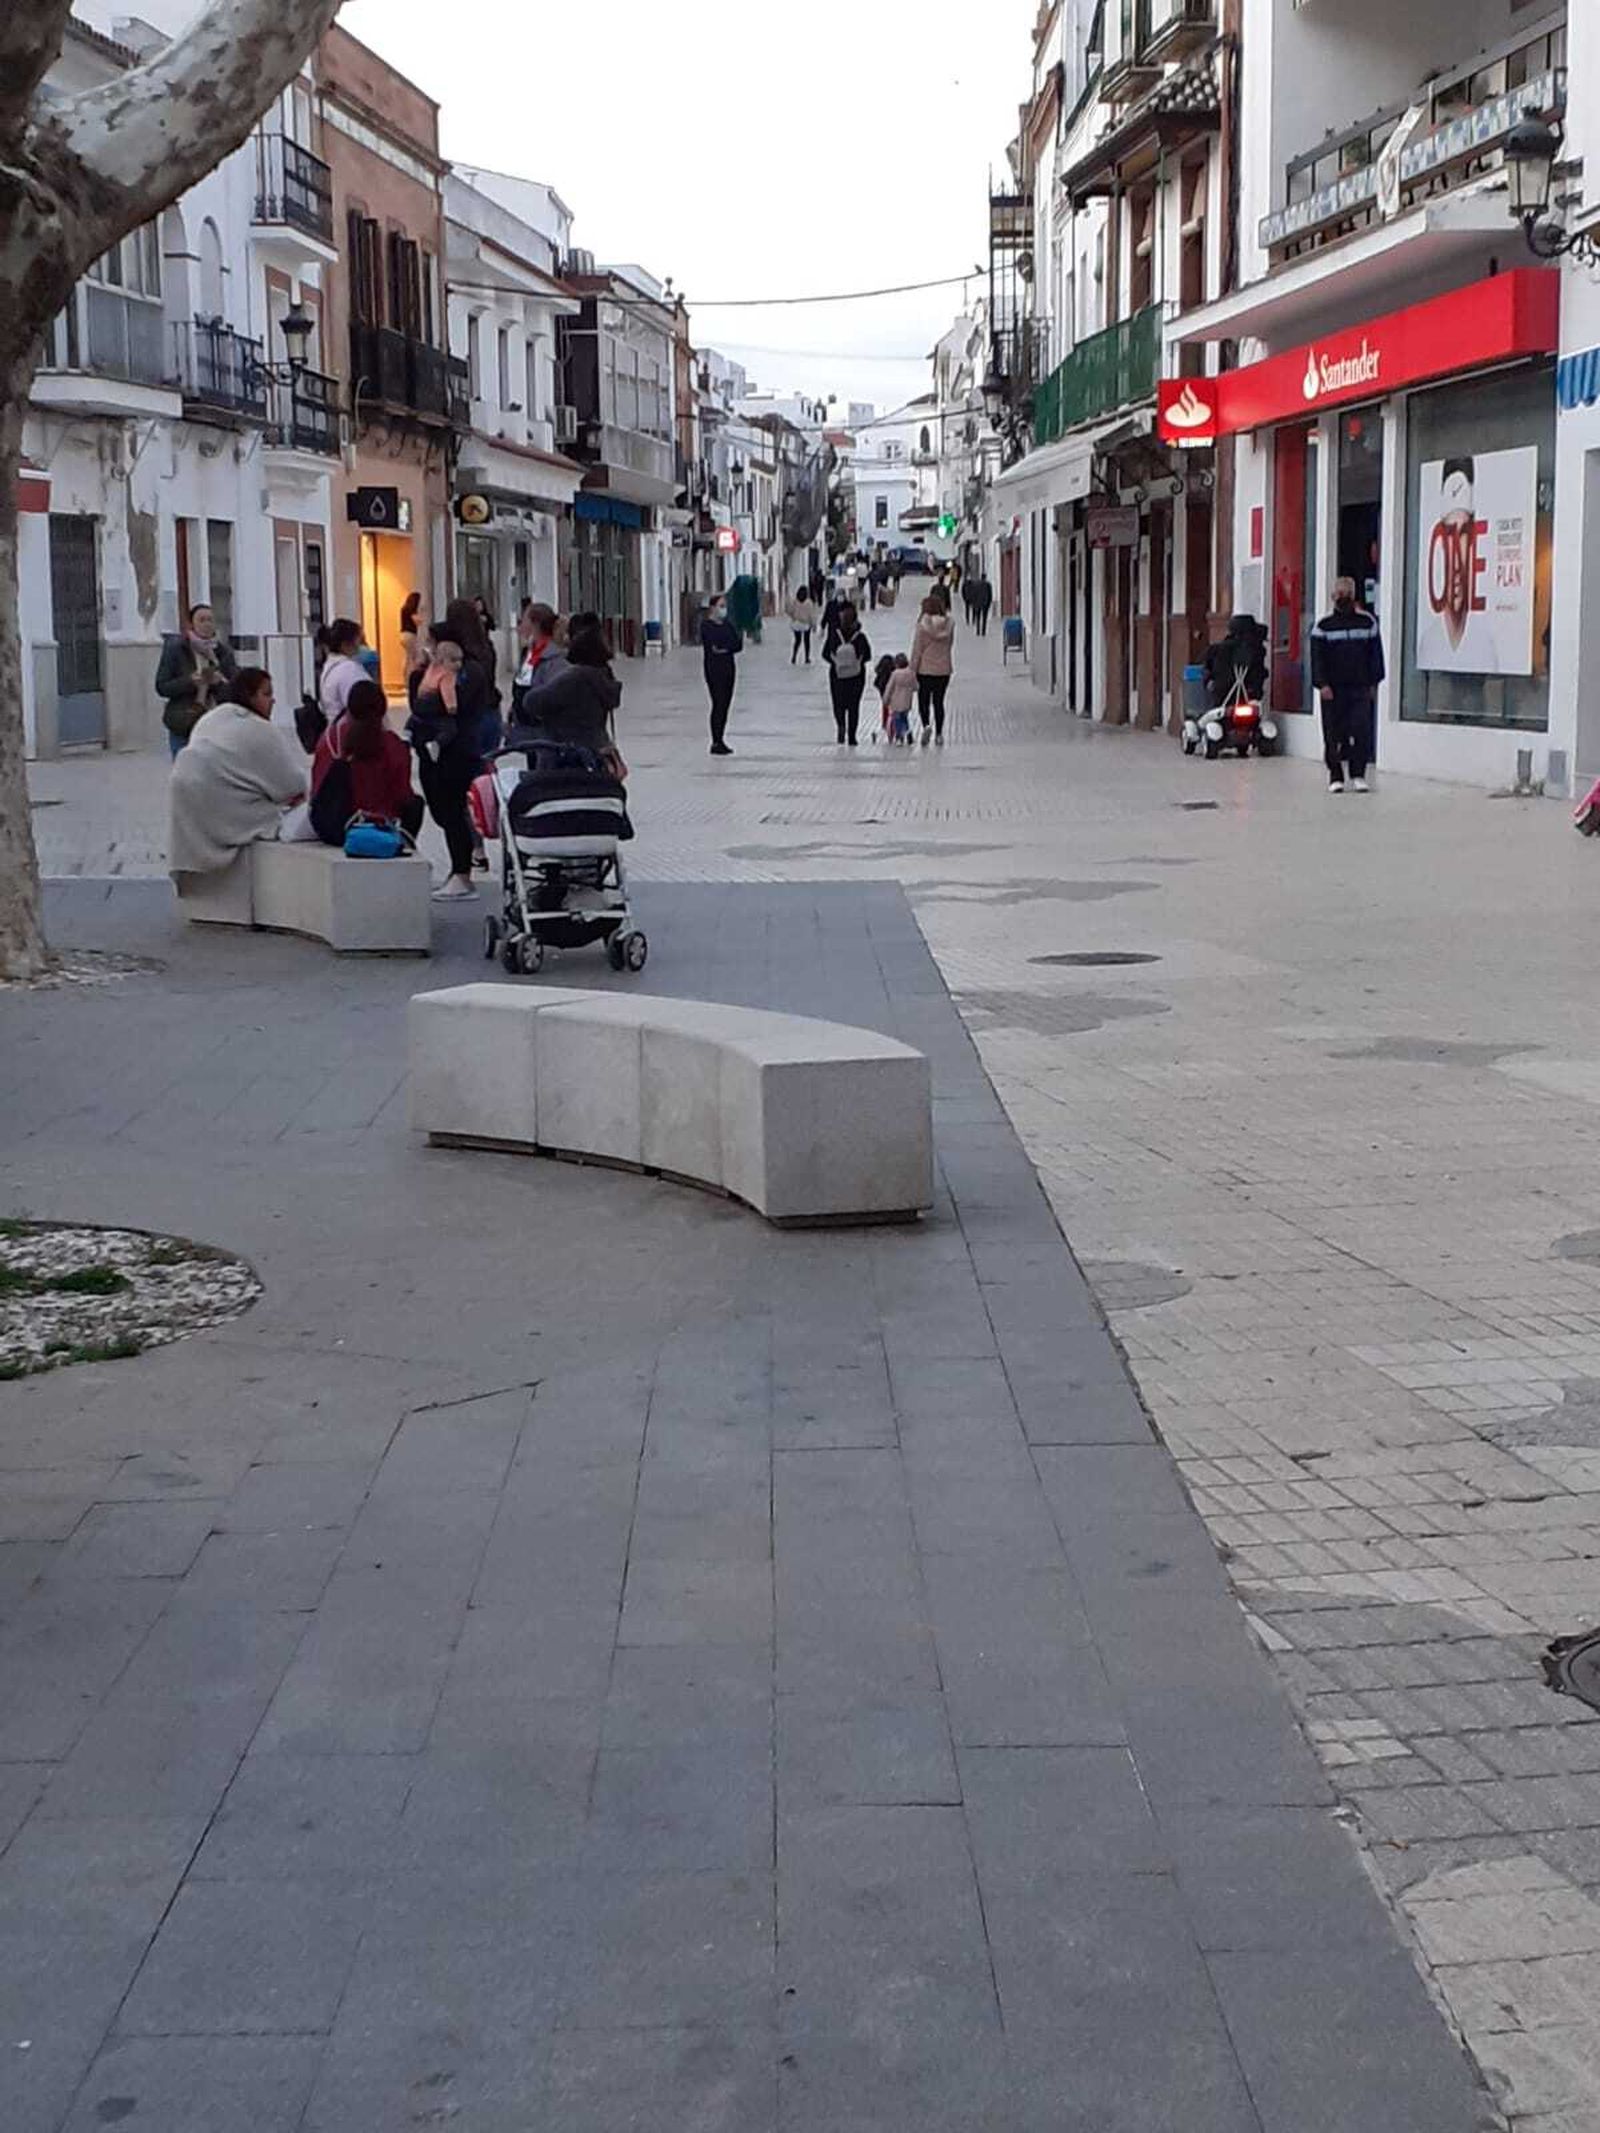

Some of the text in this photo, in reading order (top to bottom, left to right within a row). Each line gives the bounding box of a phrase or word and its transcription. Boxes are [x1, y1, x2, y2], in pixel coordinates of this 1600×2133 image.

[1320, 338, 1380, 394] Santander
[1428, 520, 1488, 613] ONE
[1496, 563, 1522, 588] PLAN
